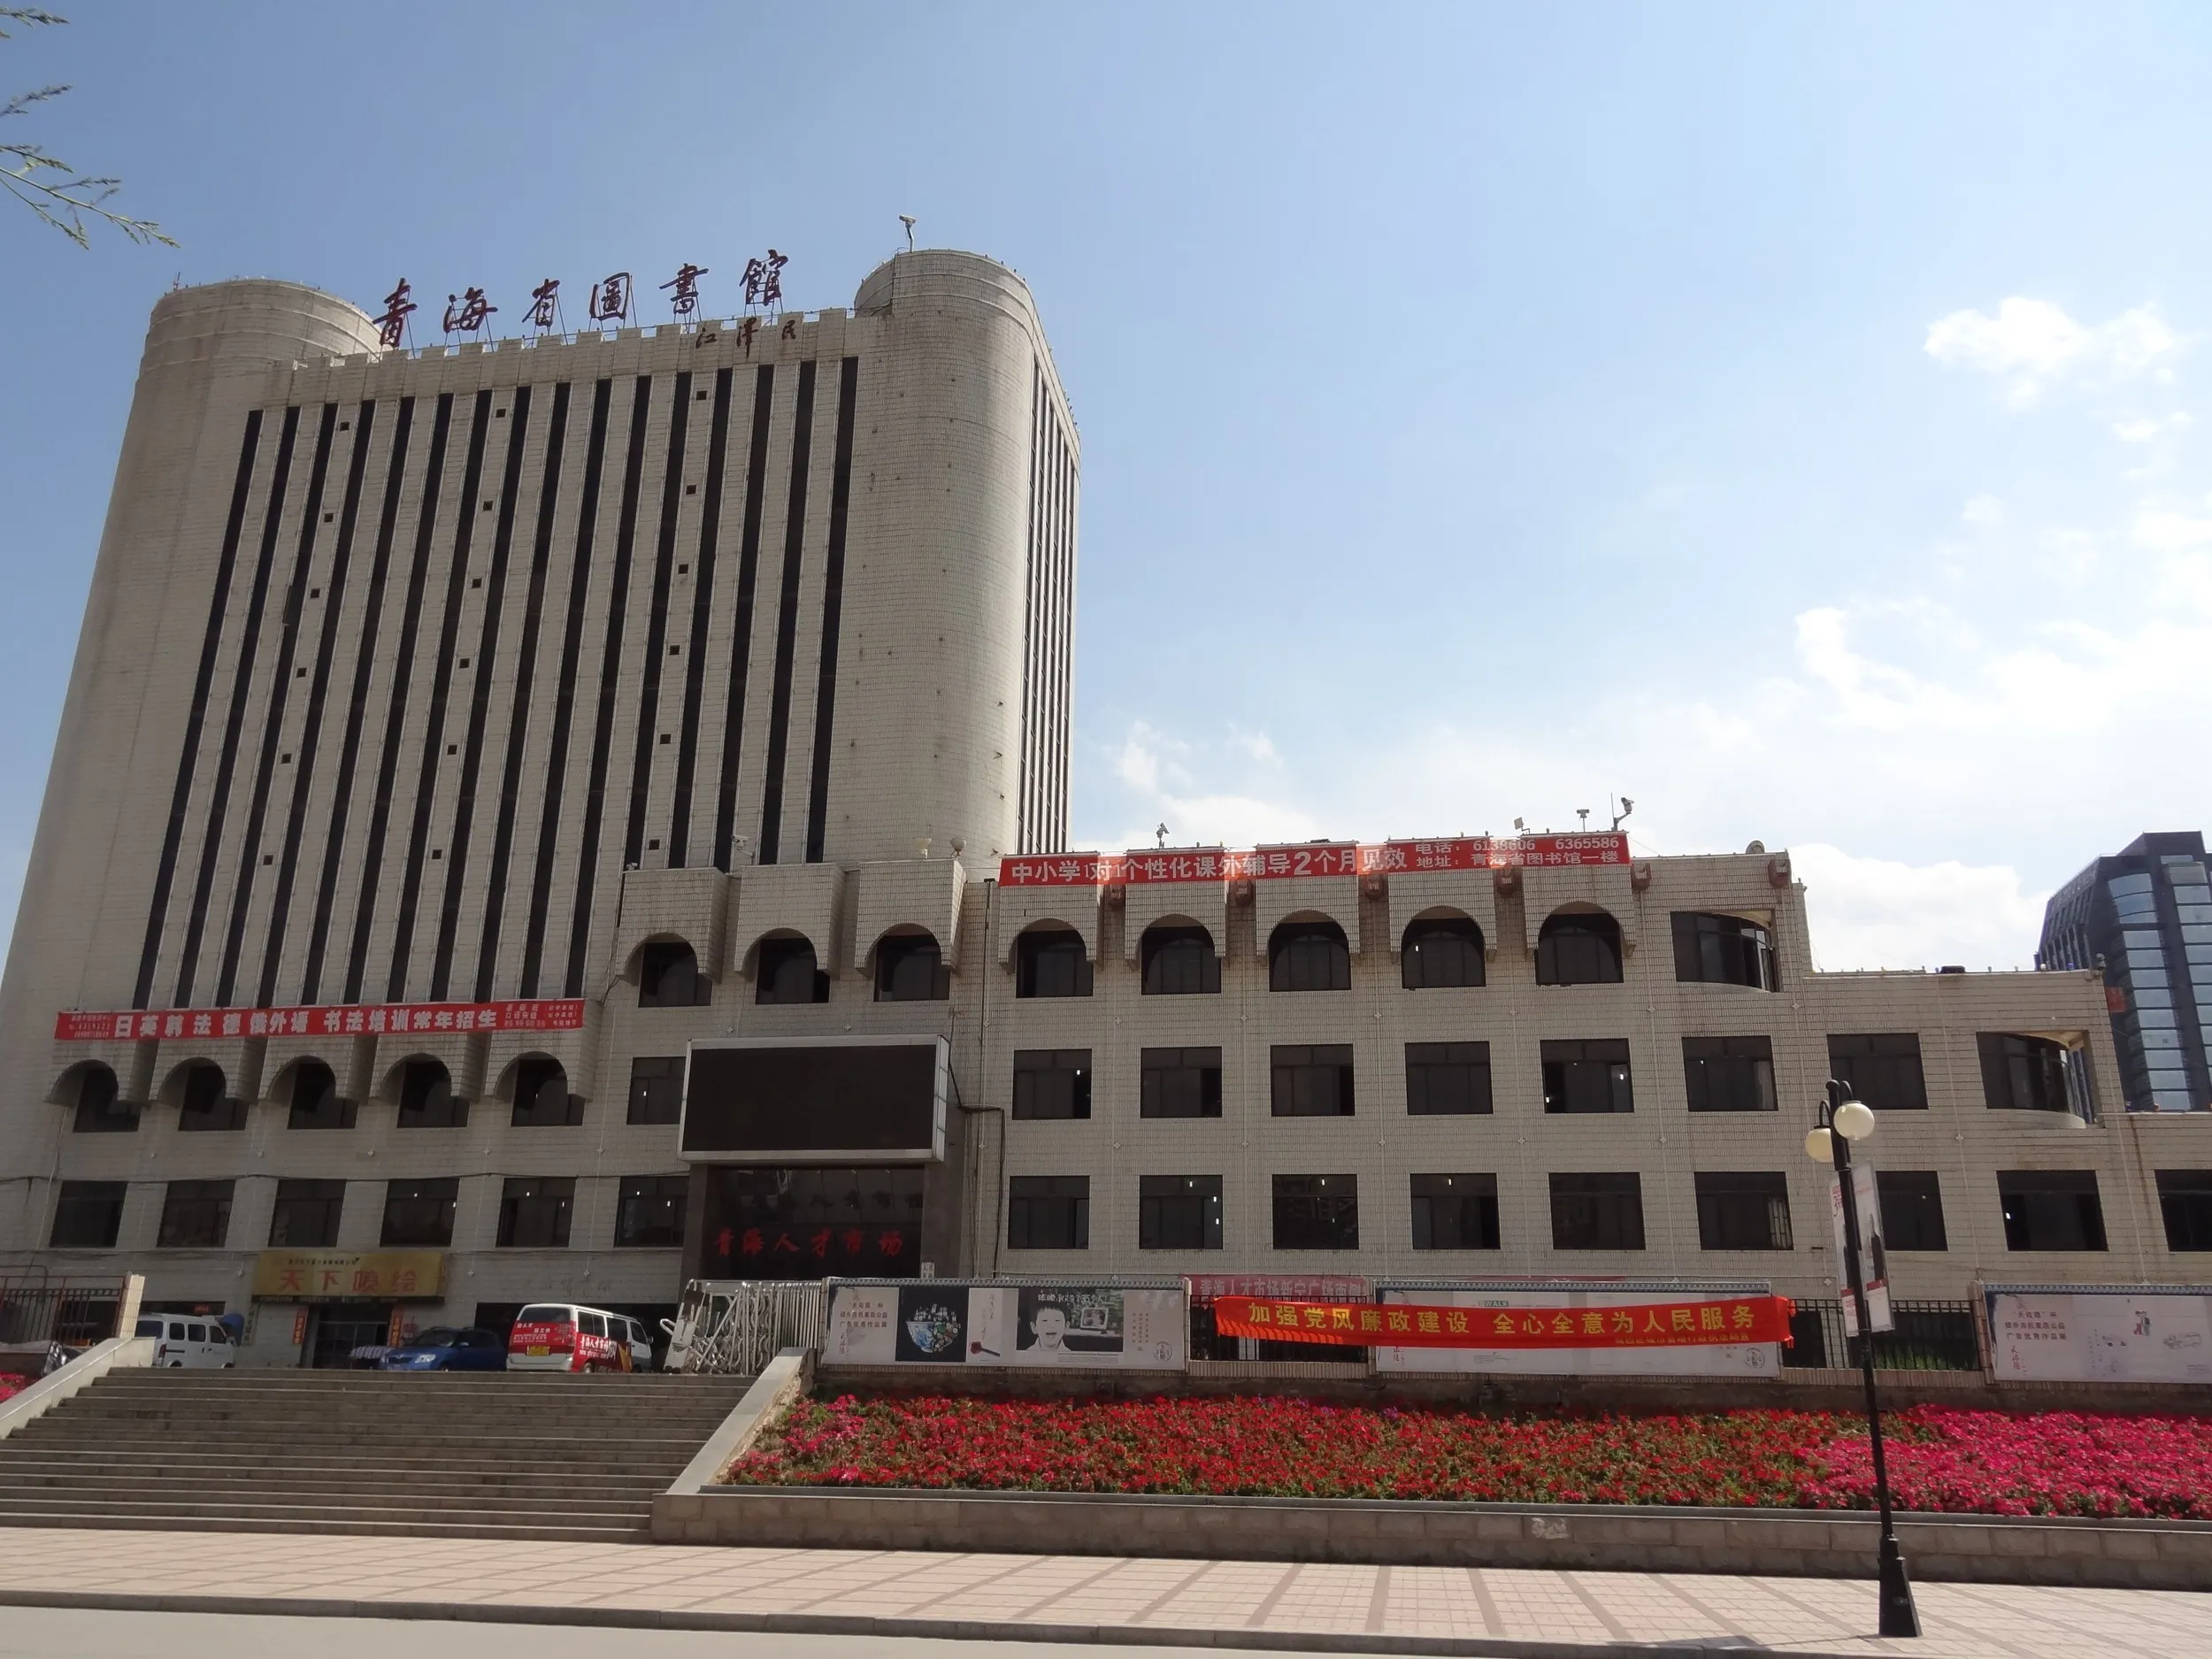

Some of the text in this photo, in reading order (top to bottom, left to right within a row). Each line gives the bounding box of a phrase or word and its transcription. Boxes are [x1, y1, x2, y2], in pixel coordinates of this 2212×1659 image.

[1555, 837, 1620, 850] 6365586
[1471, 851, 1619, 866] 青海省图书馆一楼
[278, 1268, 419, 1293] 天下喷绘
[1248, 1302, 1755, 1335] 加强党风廉政建设 全心全意为人民服务
